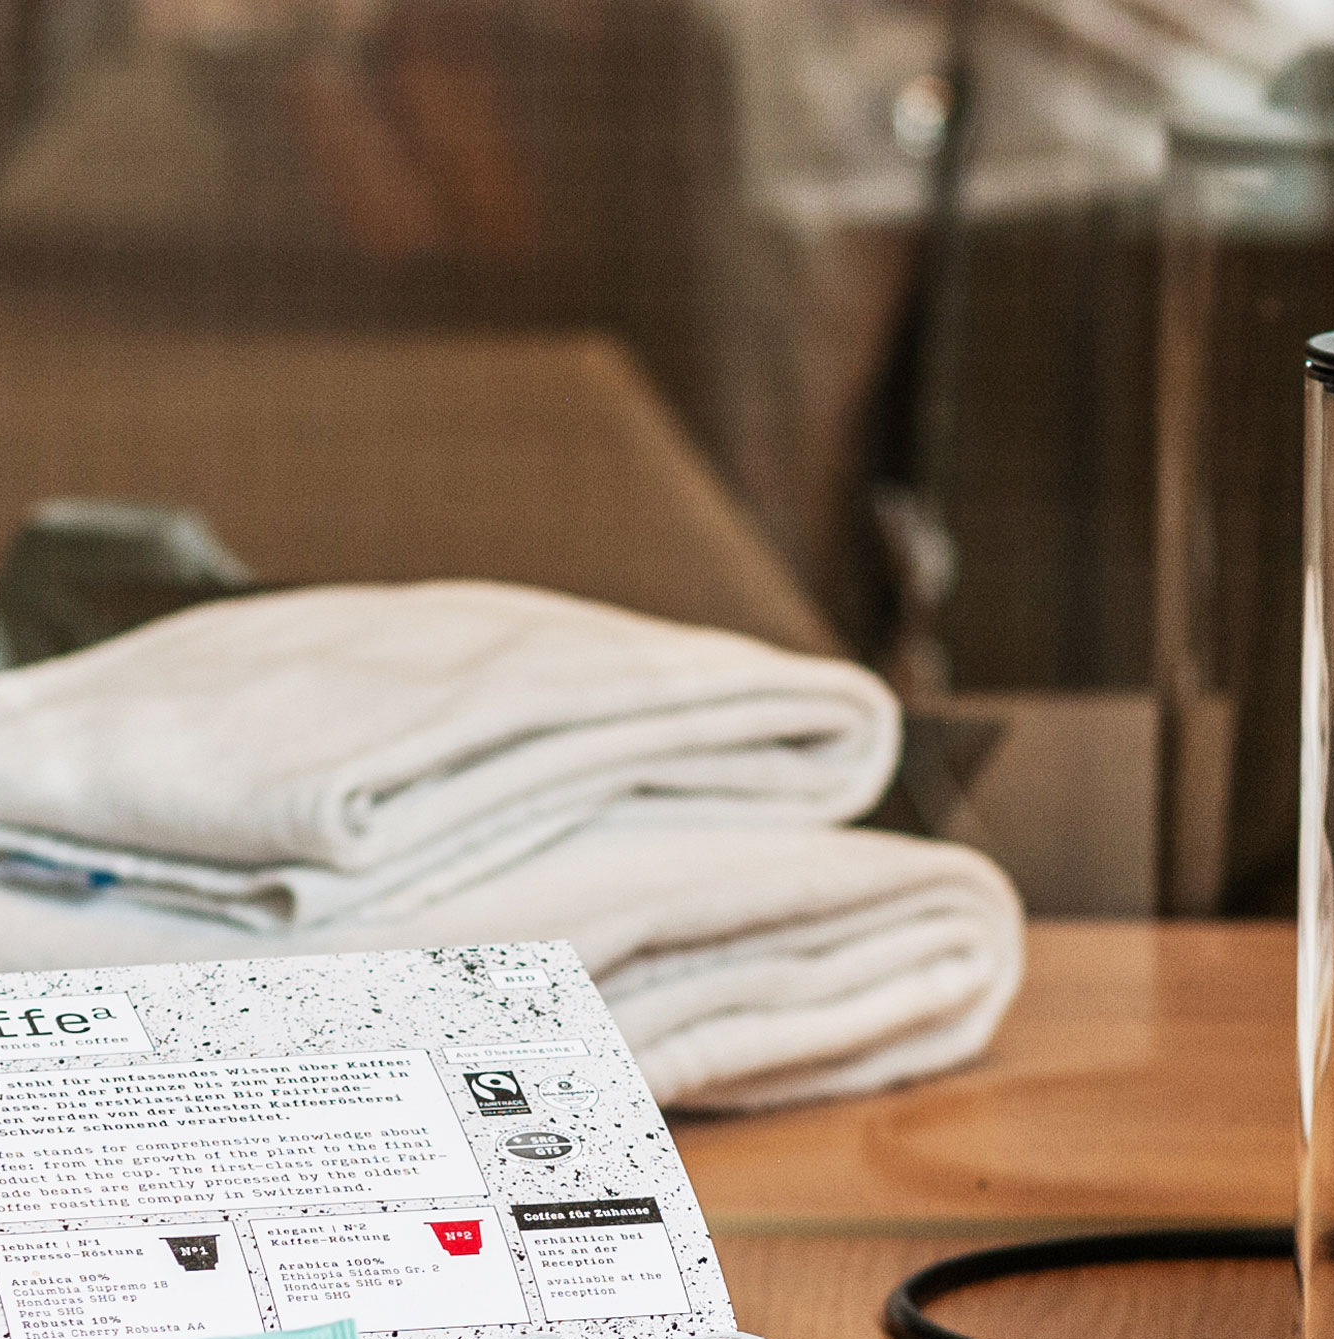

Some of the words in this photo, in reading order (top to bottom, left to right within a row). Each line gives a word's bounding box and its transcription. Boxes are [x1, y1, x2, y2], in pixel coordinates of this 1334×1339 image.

[504, 975, 536, 983] BIO
[49, 1039, 65, 1047] of
[75, 1036, 129, 1046] coffee
[455, 1051, 480, 1059] Aus
[6, 1079, 54, 1089] steht
[61, 1078, 91, 1086] für
[99, 1070, 219, 1084] umfassendes
[224, 1066, 291, 1076] Wissen
[298, 1063, 339, 1072] über
[346, 1059, 412, 1069] Kaffee:
[77, 1089, 107, 1097] der
[114, 1084, 186, 1095] Pflanze
[193, 1080, 223, 1090] bis
[230, 1079, 268, 1087] zum
[274, 1071, 380, 1085] Endprodukt
[388, 1070, 409, 1079] in
[56, 1101, 87, 1110] Die
[94, 1093, 226, 1107] erstklassigen
[232, 1090, 264, 1099] Bio
[478, 1099, 525, 1108] FAIRTRADE
[31, 1112, 99, 1123] werden
[107, 1110, 139, 1119] von
[146, 1108, 176, 1116] der
[184, 1103, 262, 1114] ältesten
[268, 1093, 403, 1109] Kaffeerösterei
[82, 1119, 169, 1132] schonend
[176, 1112, 291, 1127] verarbeitet.
[32, 1146, 94, 1157] stands
[101, 1144, 128, 1154] for
[135, 1136, 270, 1151] comprehensive
[277, 1130, 372, 1143] knowledge
[380, 1127, 429, 1137] about
[43, 1160, 87, 1170] from
[94, 1157, 123, 1167] the
[132, 1152, 197, 1166] growth
[204, 1151, 221, 1160] of
[229, 1149, 258, 1159] the
[266, 1145, 316, 1158] plant
[323, 1144, 341, 1153] to
[347, 1142, 377, 1152] the
[384, 1139, 432, 1150] final
[56, 1173, 78, 1182] in
[84, 1171, 114, 1181] the
[122, 1169, 161, 1179] cup.
[168, 1166, 203, 1176] The
[320, 1155, 391, 1167] organic
[38, 1186, 93, 1197] beans
[100, 1184, 130, 1193] are
[138, 1179, 195, 1192] gently
[203, 1173, 291, 1189] processed
[297, 1172, 318, 1183] by
[327, 1170, 357, 1180] the
[364, 1166, 420, 1178] oldest
[49, 1197, 130, 1210] roasting
[137, 1193, 215, 1205] company
[224, 1190, 245, 1200] in
[251, 1183, 372, 1198] Switzerland.
[522, 1211, 567, 1222] Coffea
[568, 1209, 592, 1220] für
[593, 1206, 651, 1218] Zuhause
[267, 1225, 325, 1236] elegant
[269, 1233, 391, 1247] Kaffee-Röstung
[533, 1234, 615, 1246] erhältlich
[619, 1231, 644, 1241] bei
[0, 1241, 59, 1252] lebhaft
[537, 1249, 565, 1257] uns
[571, 1247, 589, 1255] an
[594, 1245, 618, 1254] der
[3, 1248, 144, 1263] Espresso-Röstung
[541, 1257, 615, 1268] Reception
[278, 1260, 340, 1271] Arabica
[346, 1257, 385, 1267] 100%
[11, 1276, 73, 1287] Arabica
[78, 1273, 111, 1283] 90%
[280, 1270, 343, 1282] Ethiopia
[348, 1268, 401, 1277] Sidamo
[404, 1265, 426, 1274] Gr.
[431, 1263, 441, 1273] 2
[546, 1274, 615, 1287] available
[620, 1273, 635, 1282] at
[639, 1272, 662, 1281] the
[12, 1285, 82, 1298] Columbia
[86, 1282, 147, 1294] Supremo
[283, 1281, 351, 1292] Honduras
[355, 1278, 383, 1288] SHG
[15, 1297, 84, 1308] Honduras
[88, 1293, 117, 1304] SHG
[286, 1294, 319, 1303] Peru
[324, 1290, 351, 1301] SHG
[550, 1287, 617, 1299] reception
[18, 1310, 52, 1319] Peru
[56, 1306, 85, 1317] SHG
[21, 1318, 84, 1330] Robusta
[91, 1315, 122, 1326] 10%
[70, 1328, 120, 1338] Cherry
[124, 1324, 181, 1335] Robusta
[186, 1321, 206, 1331] AA
